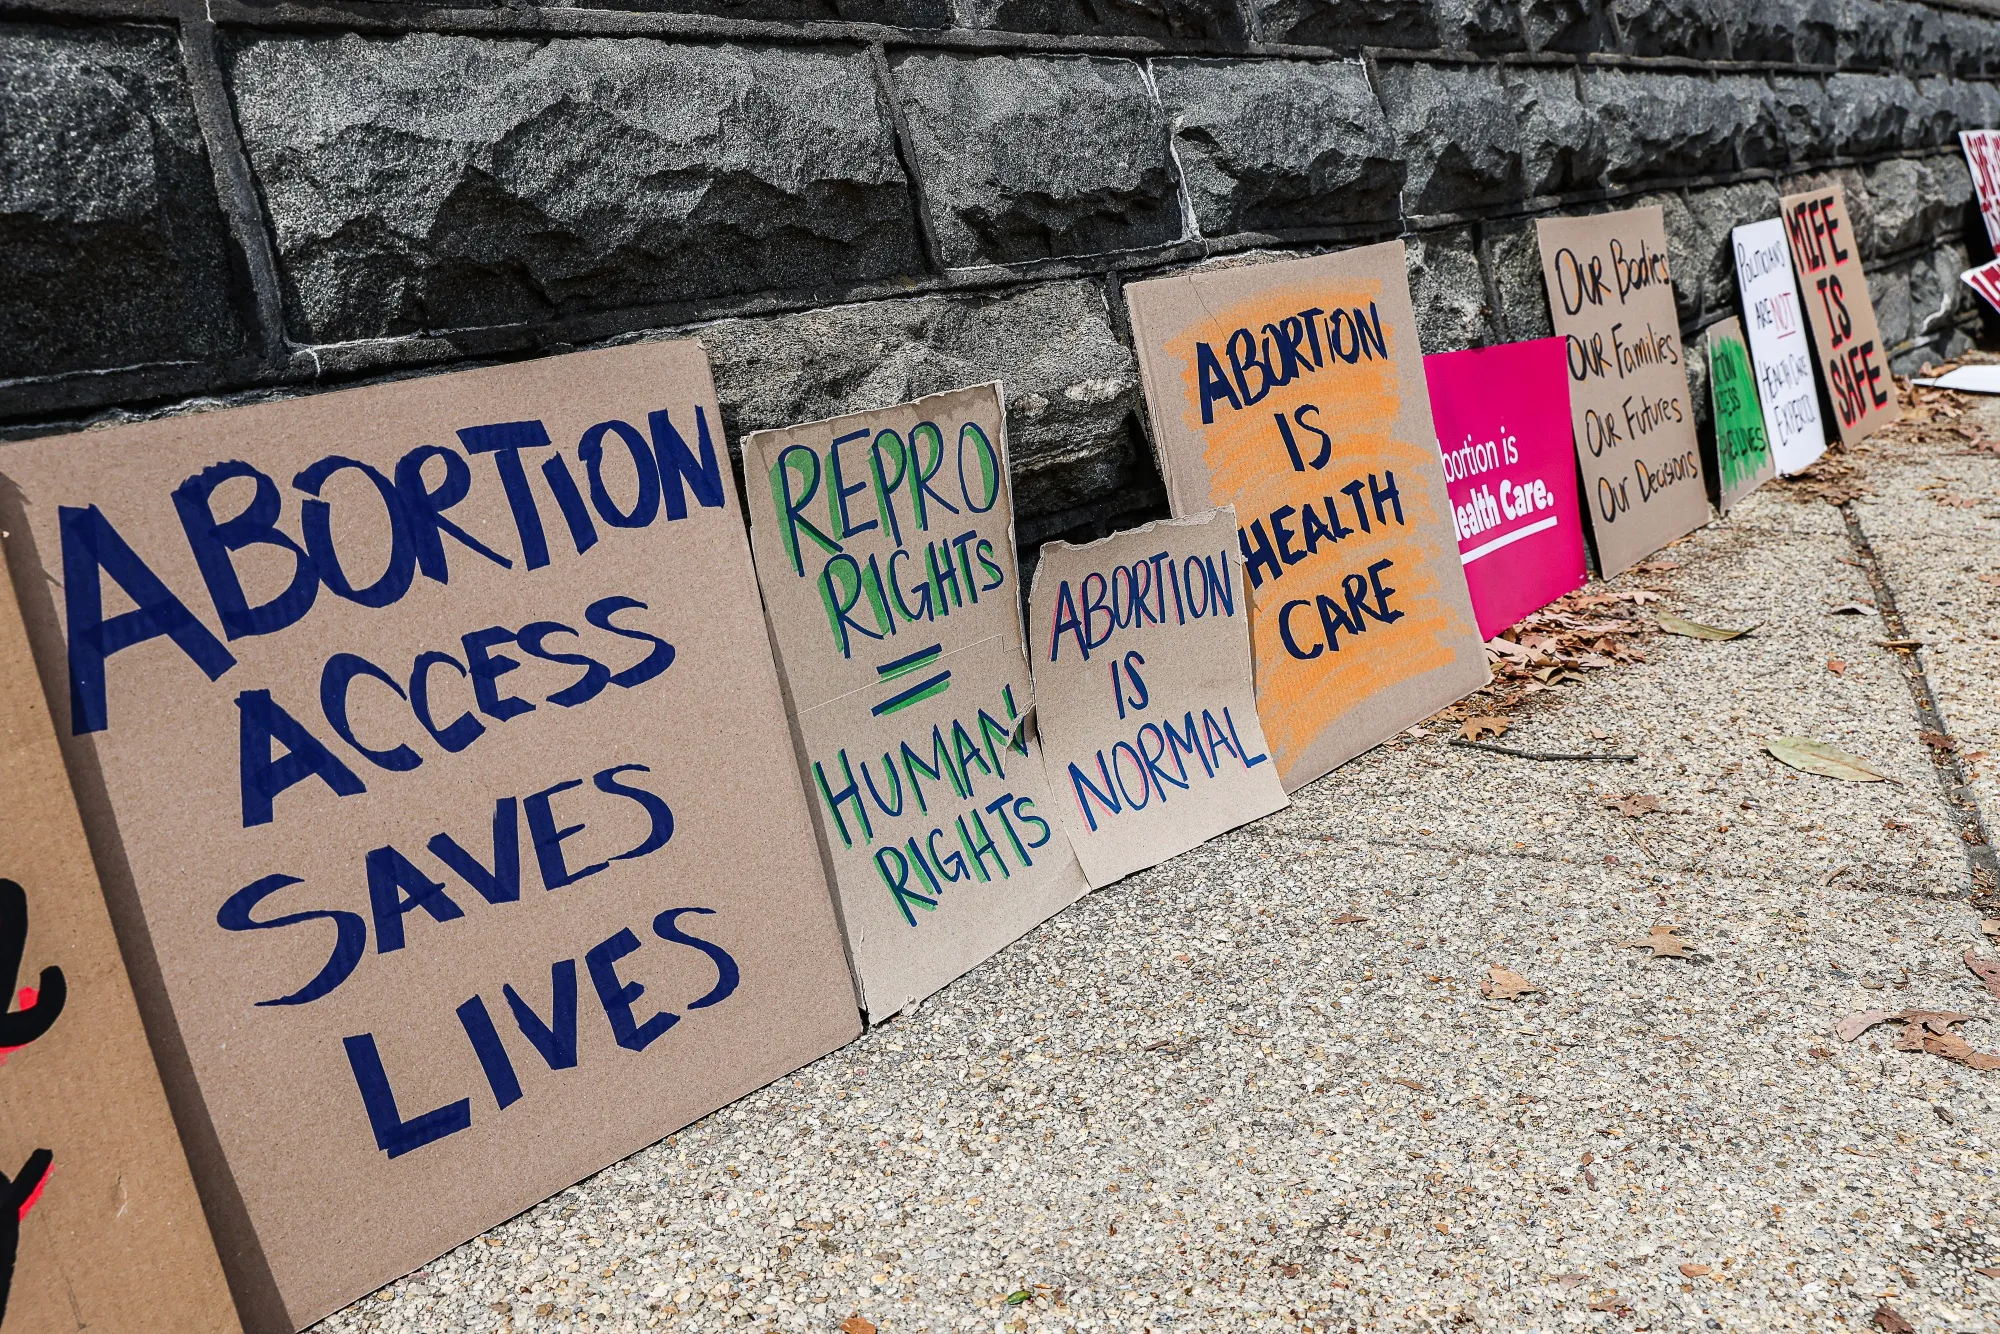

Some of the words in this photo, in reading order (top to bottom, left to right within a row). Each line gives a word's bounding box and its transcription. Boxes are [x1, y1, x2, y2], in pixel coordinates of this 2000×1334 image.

[1610, 238, 1670, 305] Bodies
[1786, 196, 1848, 275] MIFE
[1196, 300, 1389, 425] ABORTION
[1611, 322, 1678, 379] Families
[1770, 292, 1796, 333] NOT
[1816, 274, 1852, 350] IS
[1622, 395, 1682, 440] Futures
[1829, 340, 1888, 428] SAFE
[1274, 404, 1332, 472] IS
[1437, 434, 1499, 483] bortion
[1500, 426, 1519, 465] is
[1635, 451, 1698, 503] Decisions
[769, 420, 1000, 577] REPRO
[1239, 470, 1404, 590] HEALTH
[1500, 479, 1554, 521] Care.
[58, 405, 725, 736] ABORTION
[817, 530, 1004, 659] RIGHTS
[1049, 550, 1235, 662] ABORTION
[1279, 558, 1405, 660] CARE
[234, 595, 676, 828] ACCESS
[1110, 650, 1150, 719] IS
[811, 683, 1029, 850] HUMAN
[1068, 706, 1267, 834] NORMAL
[216, 763, 675, 1007] SAVES
[873, 792, 1051, 927] RIGHTS
[342, 906, 740, 1160] LIVES
